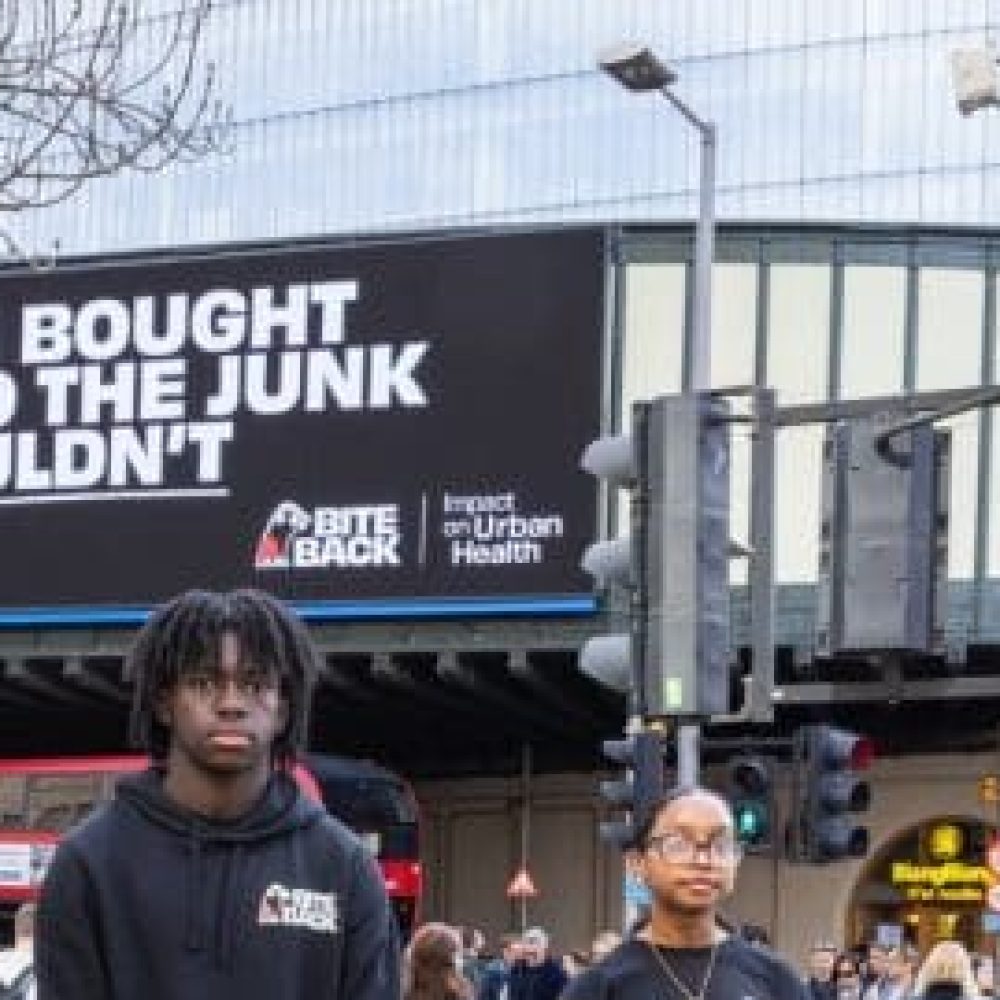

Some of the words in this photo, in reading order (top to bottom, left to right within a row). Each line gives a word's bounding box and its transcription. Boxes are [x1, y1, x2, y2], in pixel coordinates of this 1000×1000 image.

[22, 279, 359, 363] BOUGHT
[35, 357, 186, 426] THE
[205, 340, 430, 416] JUNK
[313, 503, 400, 537] BITE
[473, 514, 565, 541] Urban
[294, 536, 401, 568] BACK
[451, 540, 545, 565] Health
